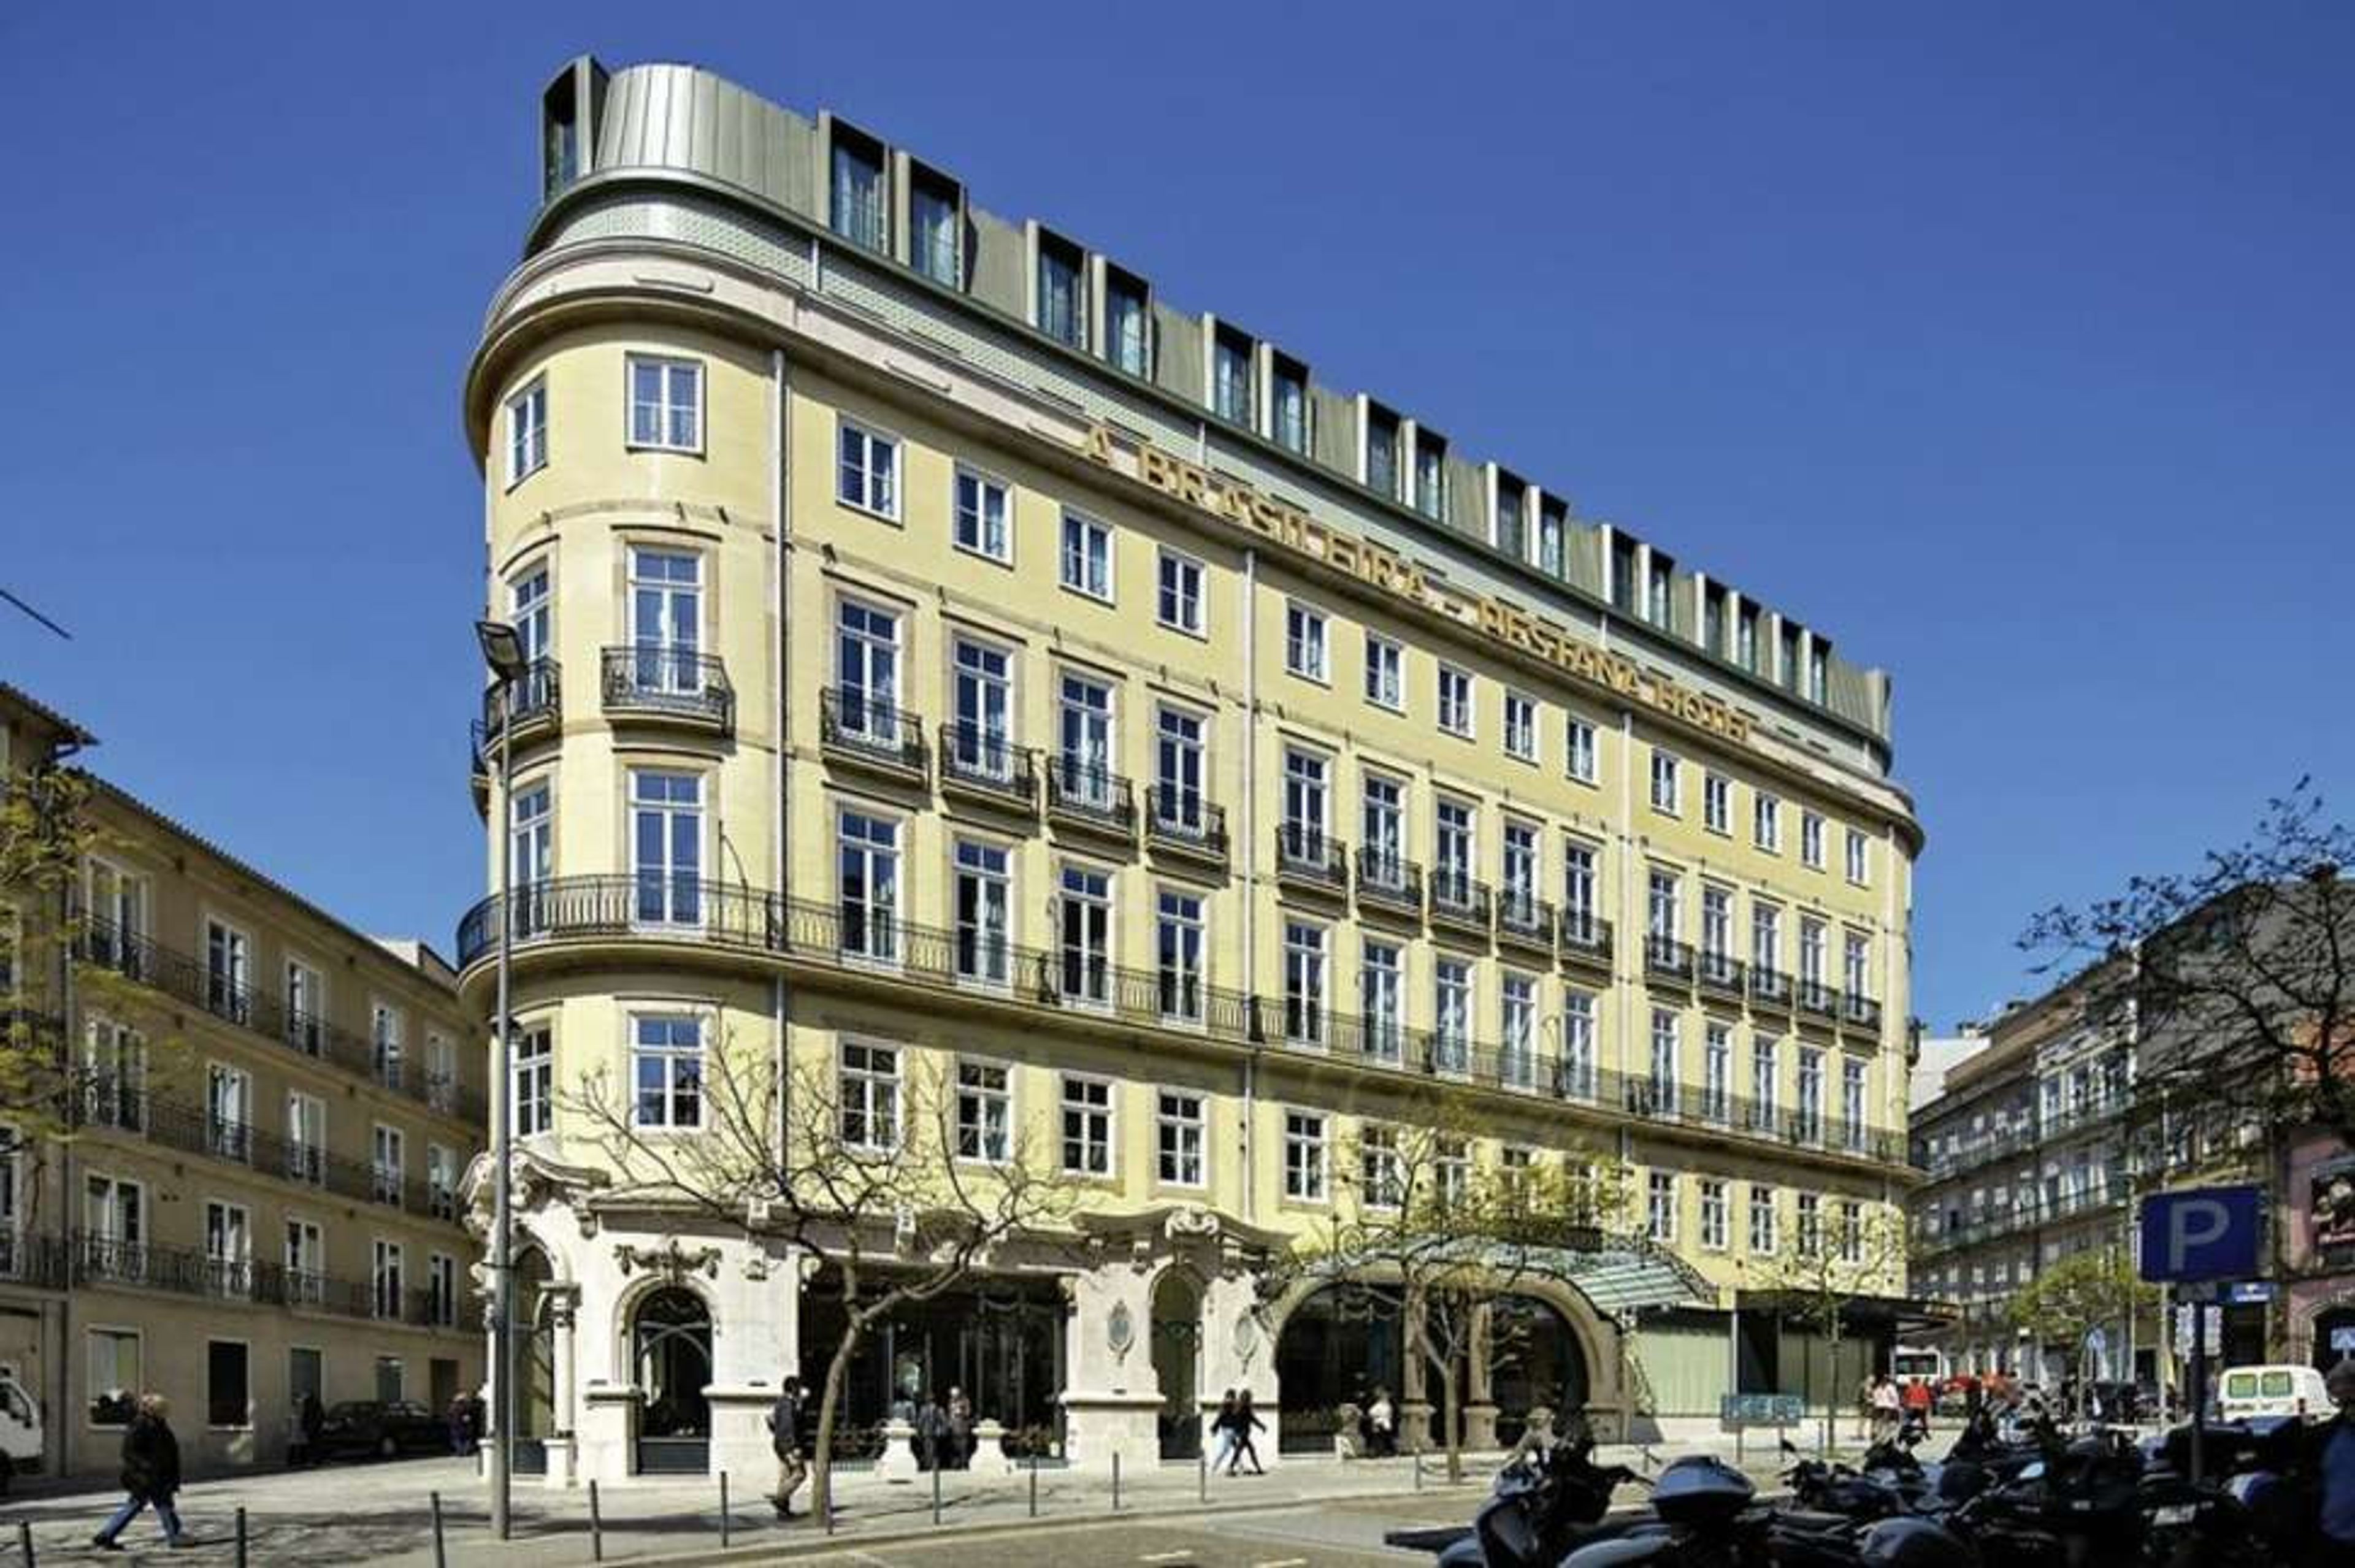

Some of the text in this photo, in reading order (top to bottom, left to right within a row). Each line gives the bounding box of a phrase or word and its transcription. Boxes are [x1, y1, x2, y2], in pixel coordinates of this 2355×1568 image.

[1083, 424, 1111, 465] A
[1139, 443, 1428, 600] BRASILEIRA
[1478, 596, 1640, 698] PESTANA
[1653, 676, 1752, 742] HOTEL
[2169, 1198, 2231, 1272] P
